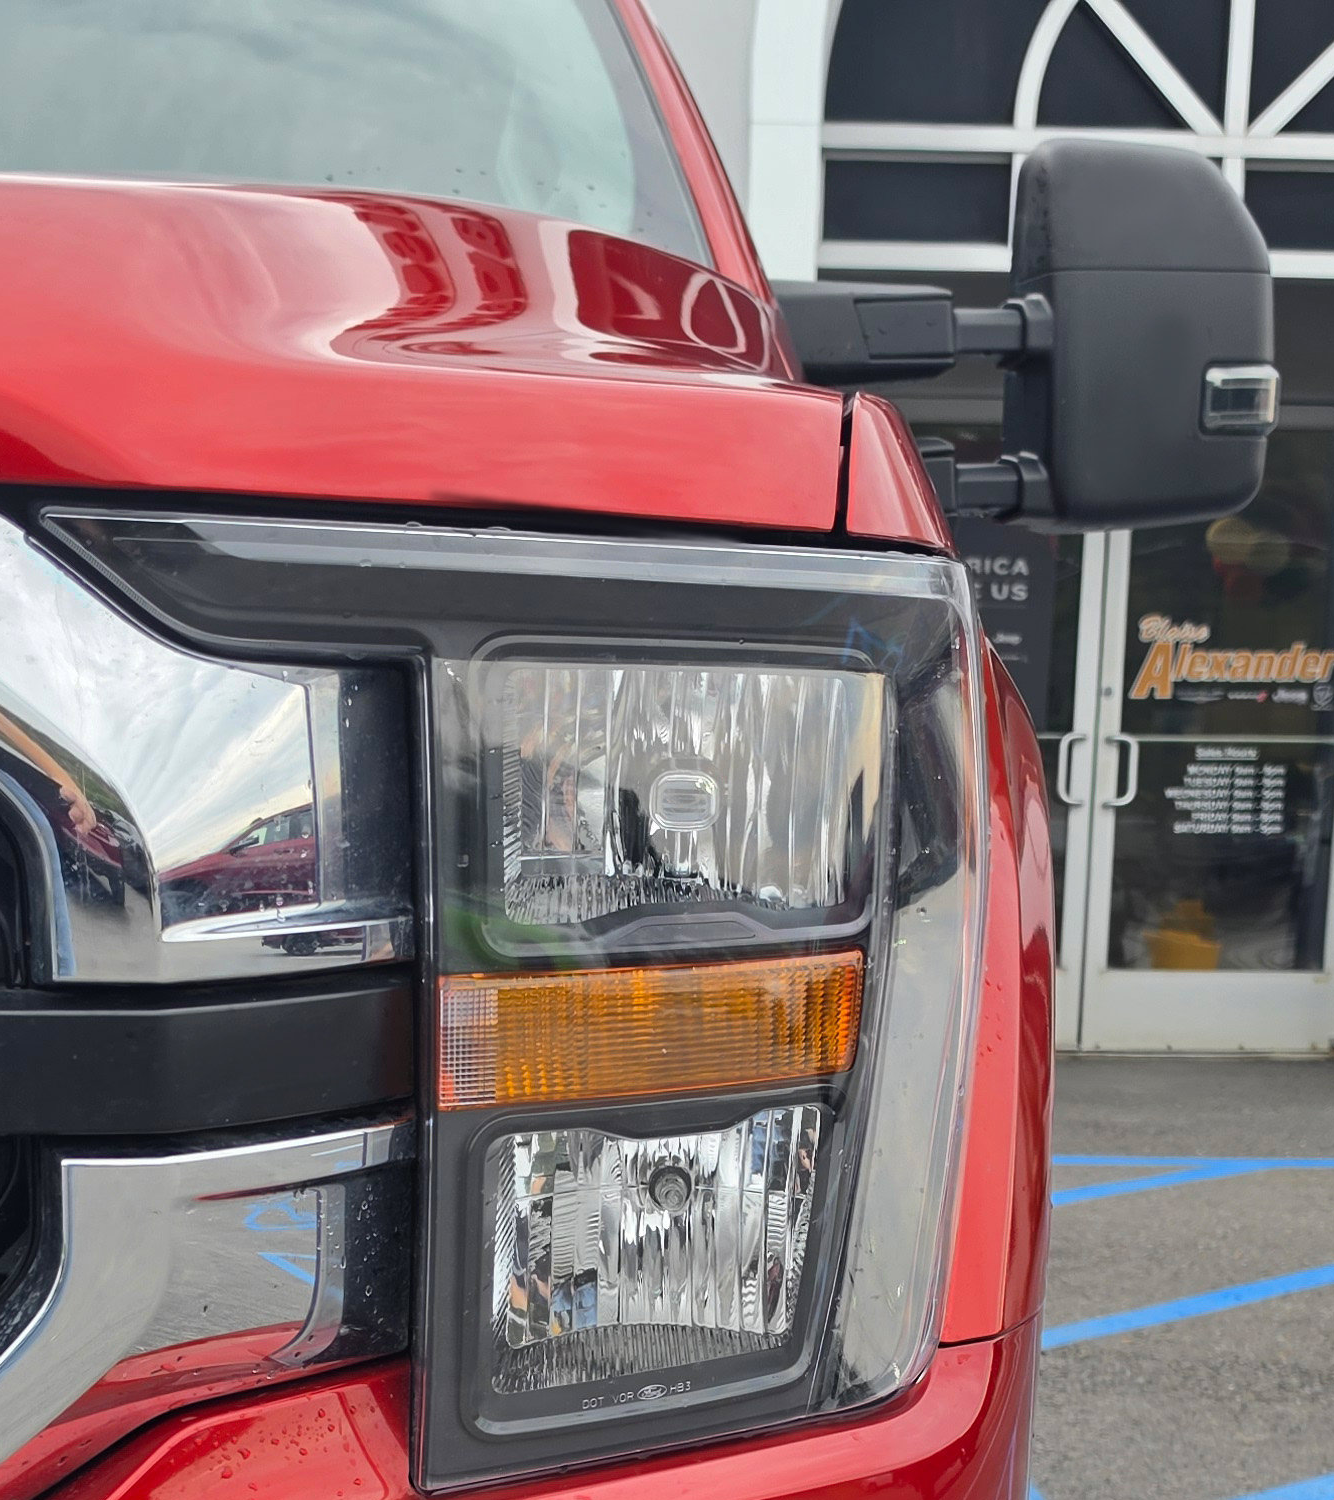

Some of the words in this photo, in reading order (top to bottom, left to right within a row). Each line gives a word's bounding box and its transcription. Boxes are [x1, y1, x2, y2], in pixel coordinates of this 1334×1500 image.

[990, 582, 1028, 601] US
[582, 1397, 604, 1409] DOT
[670, 1381, 691, 1394] HB3
